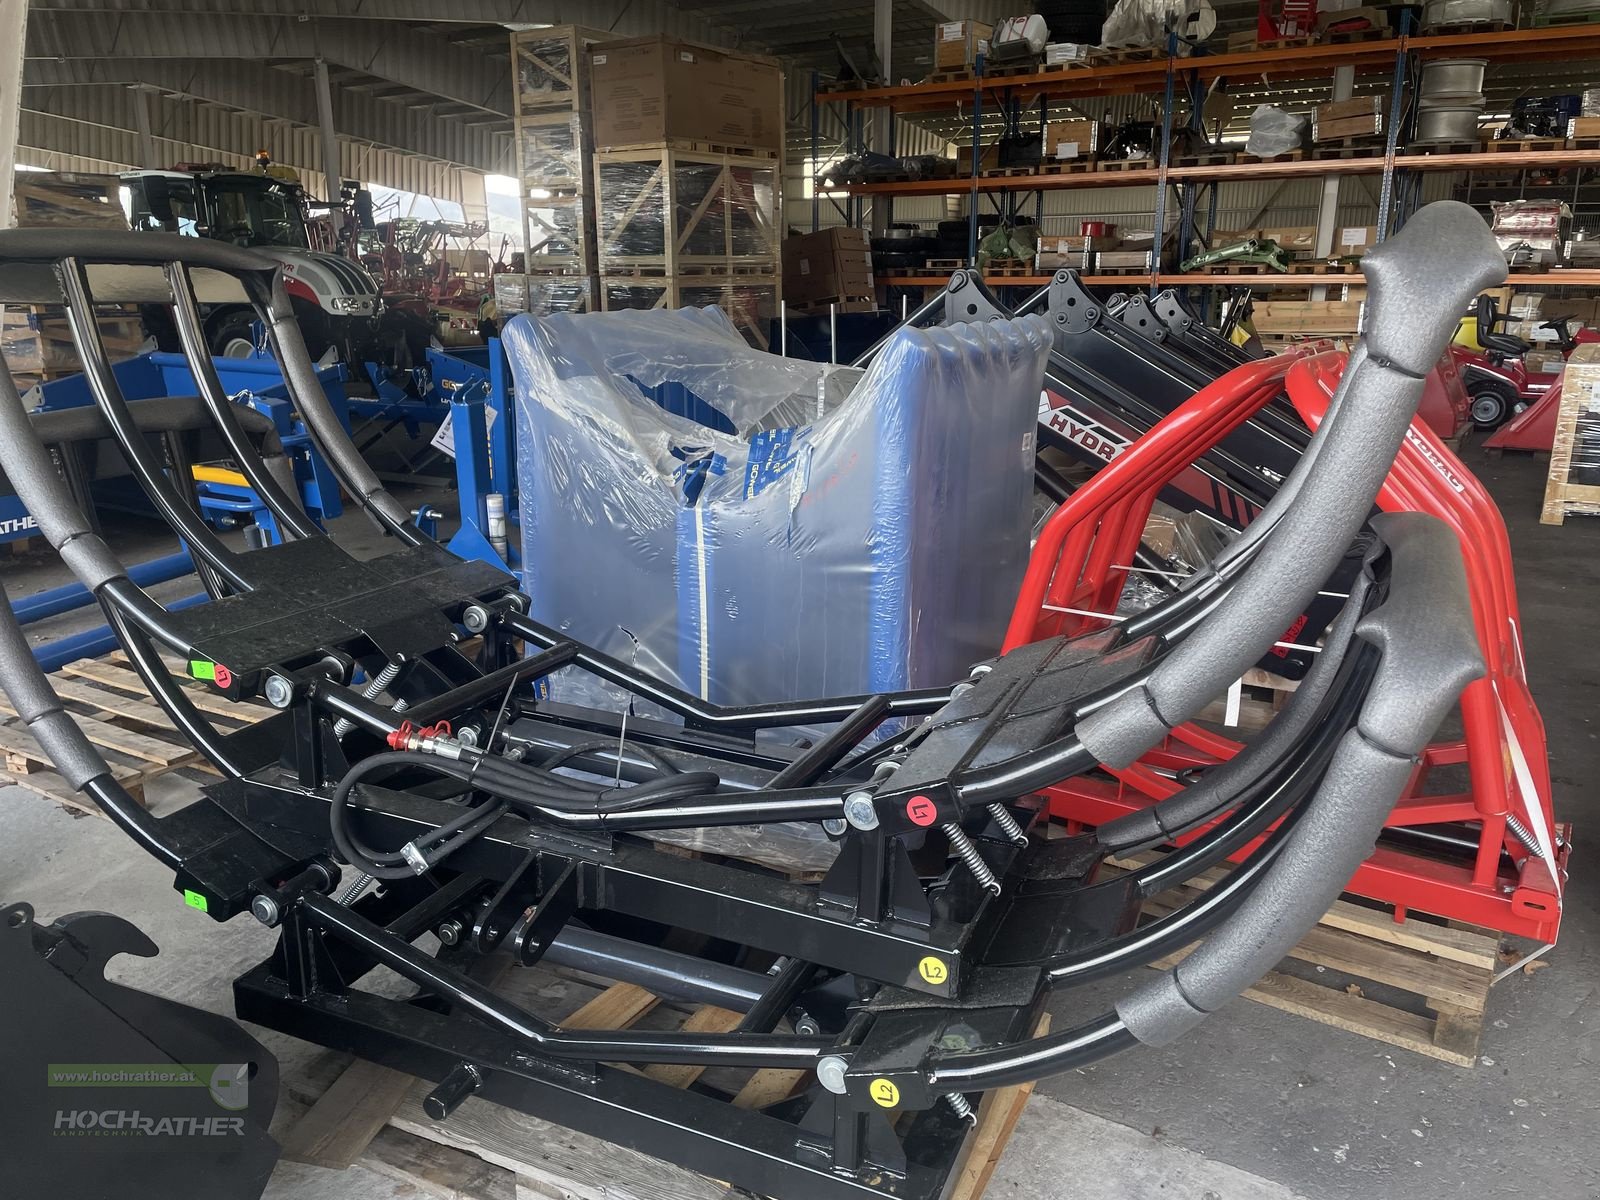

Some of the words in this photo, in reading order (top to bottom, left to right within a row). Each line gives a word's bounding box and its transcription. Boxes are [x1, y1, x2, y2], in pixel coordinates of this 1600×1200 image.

[1408, 429, 1461, 488] YDRAC
[0, 515, 39, 535] THE
[912, 804, 929, 819] L1
[924, 962, 943, 979] L2
[877, 1084, 894, 1102] L2
